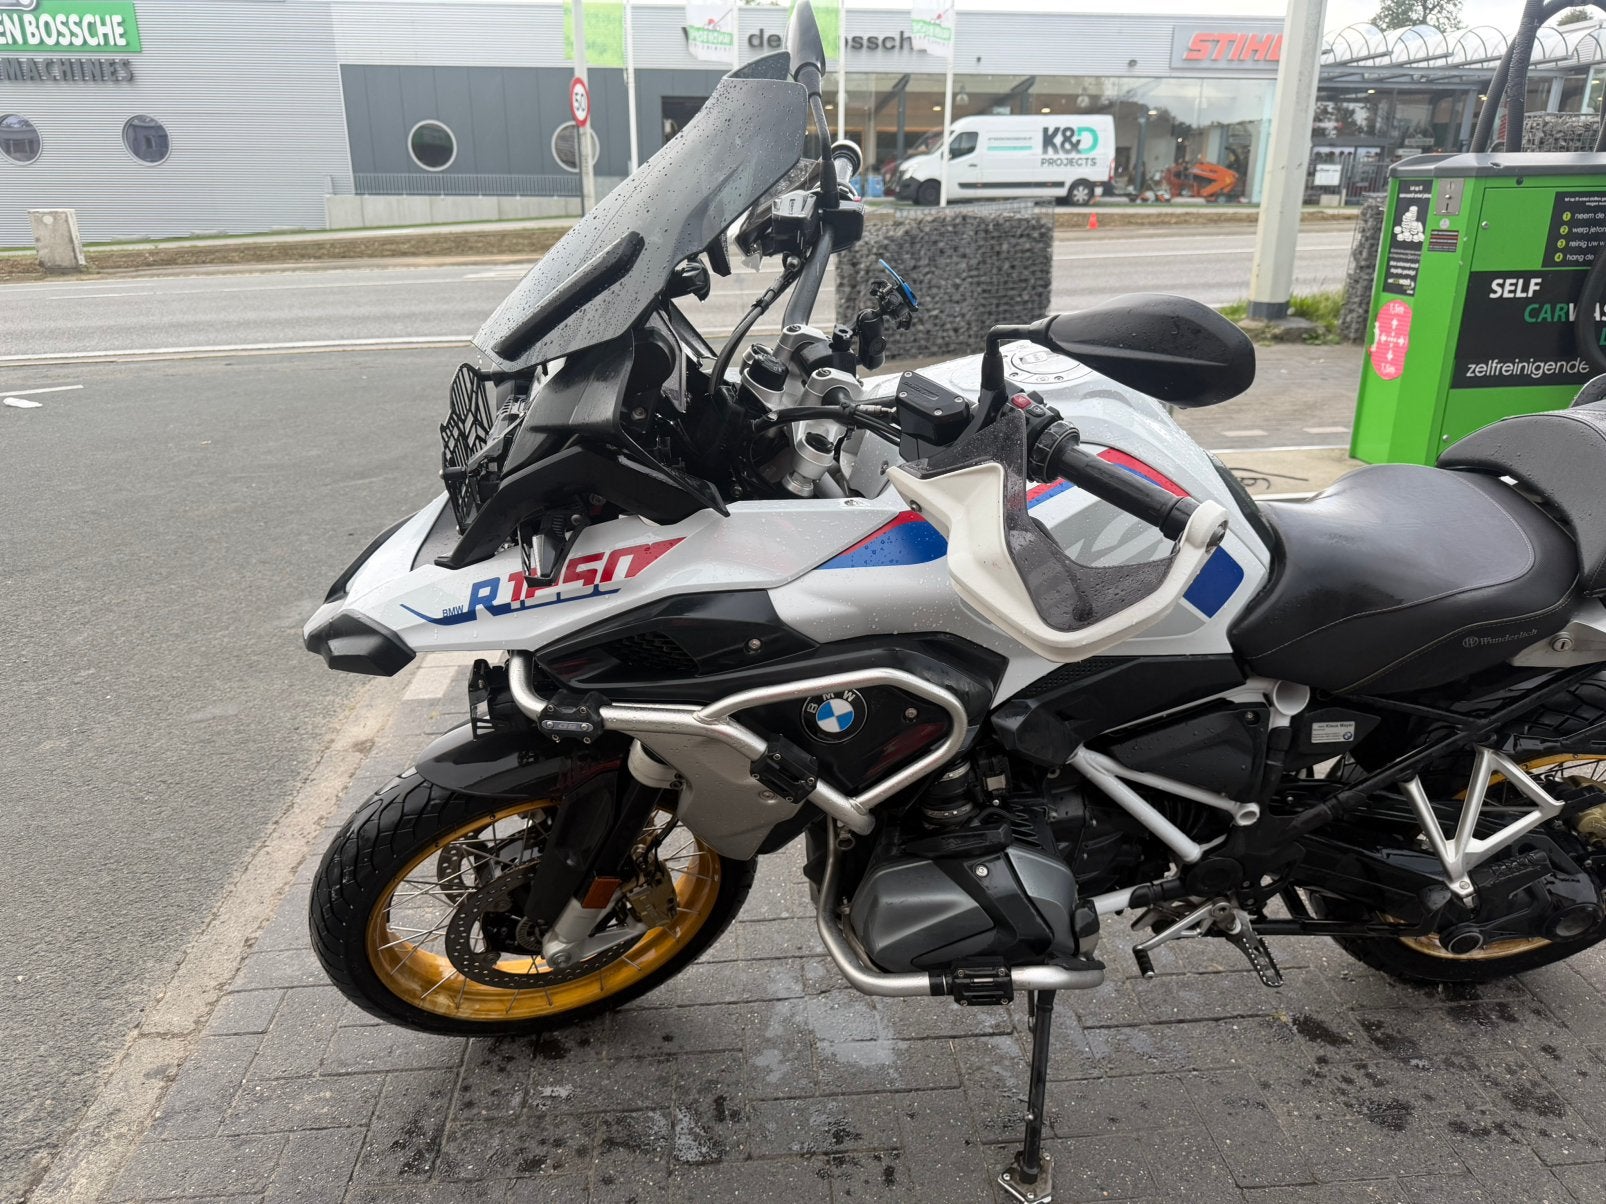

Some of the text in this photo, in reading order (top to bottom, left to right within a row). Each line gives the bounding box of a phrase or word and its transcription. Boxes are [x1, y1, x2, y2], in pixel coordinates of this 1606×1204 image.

[23, 13, 127, 46] BOSSCHE
[748, 28, 782, 48] de
[844, 30, 927, 53] ssch
[2, 57, 134, 82] MACHINES
[1042, 127, 1099, 155] K&D
[1041, 157, 1097, 167] PROJECTS
[1568, 240, 1587, 248] reinig
[1566, 254, 1584, 262] hang
[1489, 278, 1542, 298] SELF
[1466, 357, 1590, 378] zelfreinigende
[442, 604, 464, 618] BMW
[1480, 628, 1538, 645] Wunderlich
[806, 690, 856, 714] BMW
